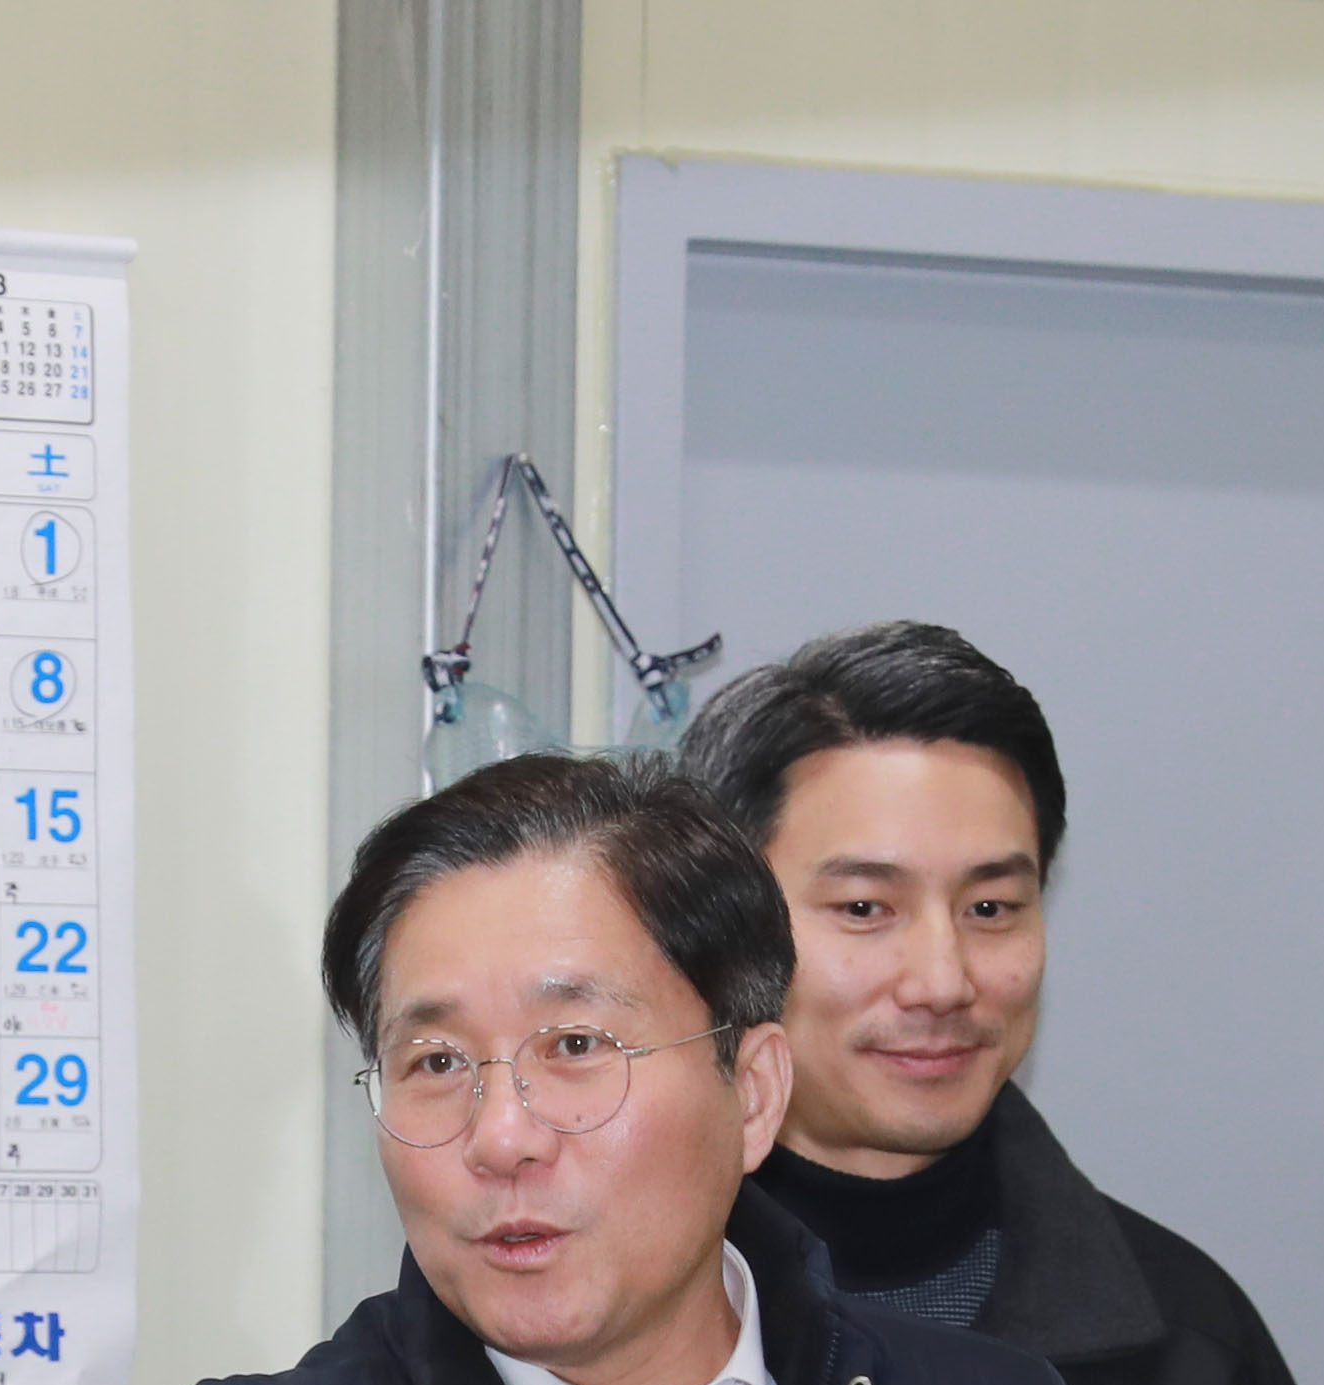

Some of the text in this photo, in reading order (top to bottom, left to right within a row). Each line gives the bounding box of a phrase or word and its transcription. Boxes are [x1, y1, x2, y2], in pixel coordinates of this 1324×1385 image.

[20, 342, 36, 356] 12
[46, 344, 62, 357] 13
[72, 346, 87, 359] 14
[23, 322, 31, 335] 5
[48, 324, 56, 337] 6
[75, 325, 82, 338] 7
[18, 382, 36, 396] 26
[44, 383, 62, 397] 27
[71, 386, 88, 399] 28
[20, 362, 36, 376] 19
[44, 364, 62, 377] 20
[71, 366, 88, 379] 21
[28, 444, 69, 477] 土
[34, 519, 56, 575] 1
[31, 652, 64, 704] 8
[15, 788, 81, 843] 15
[15, 920, 88, 974] 22
[15, 1053, 88, 1106] 29
